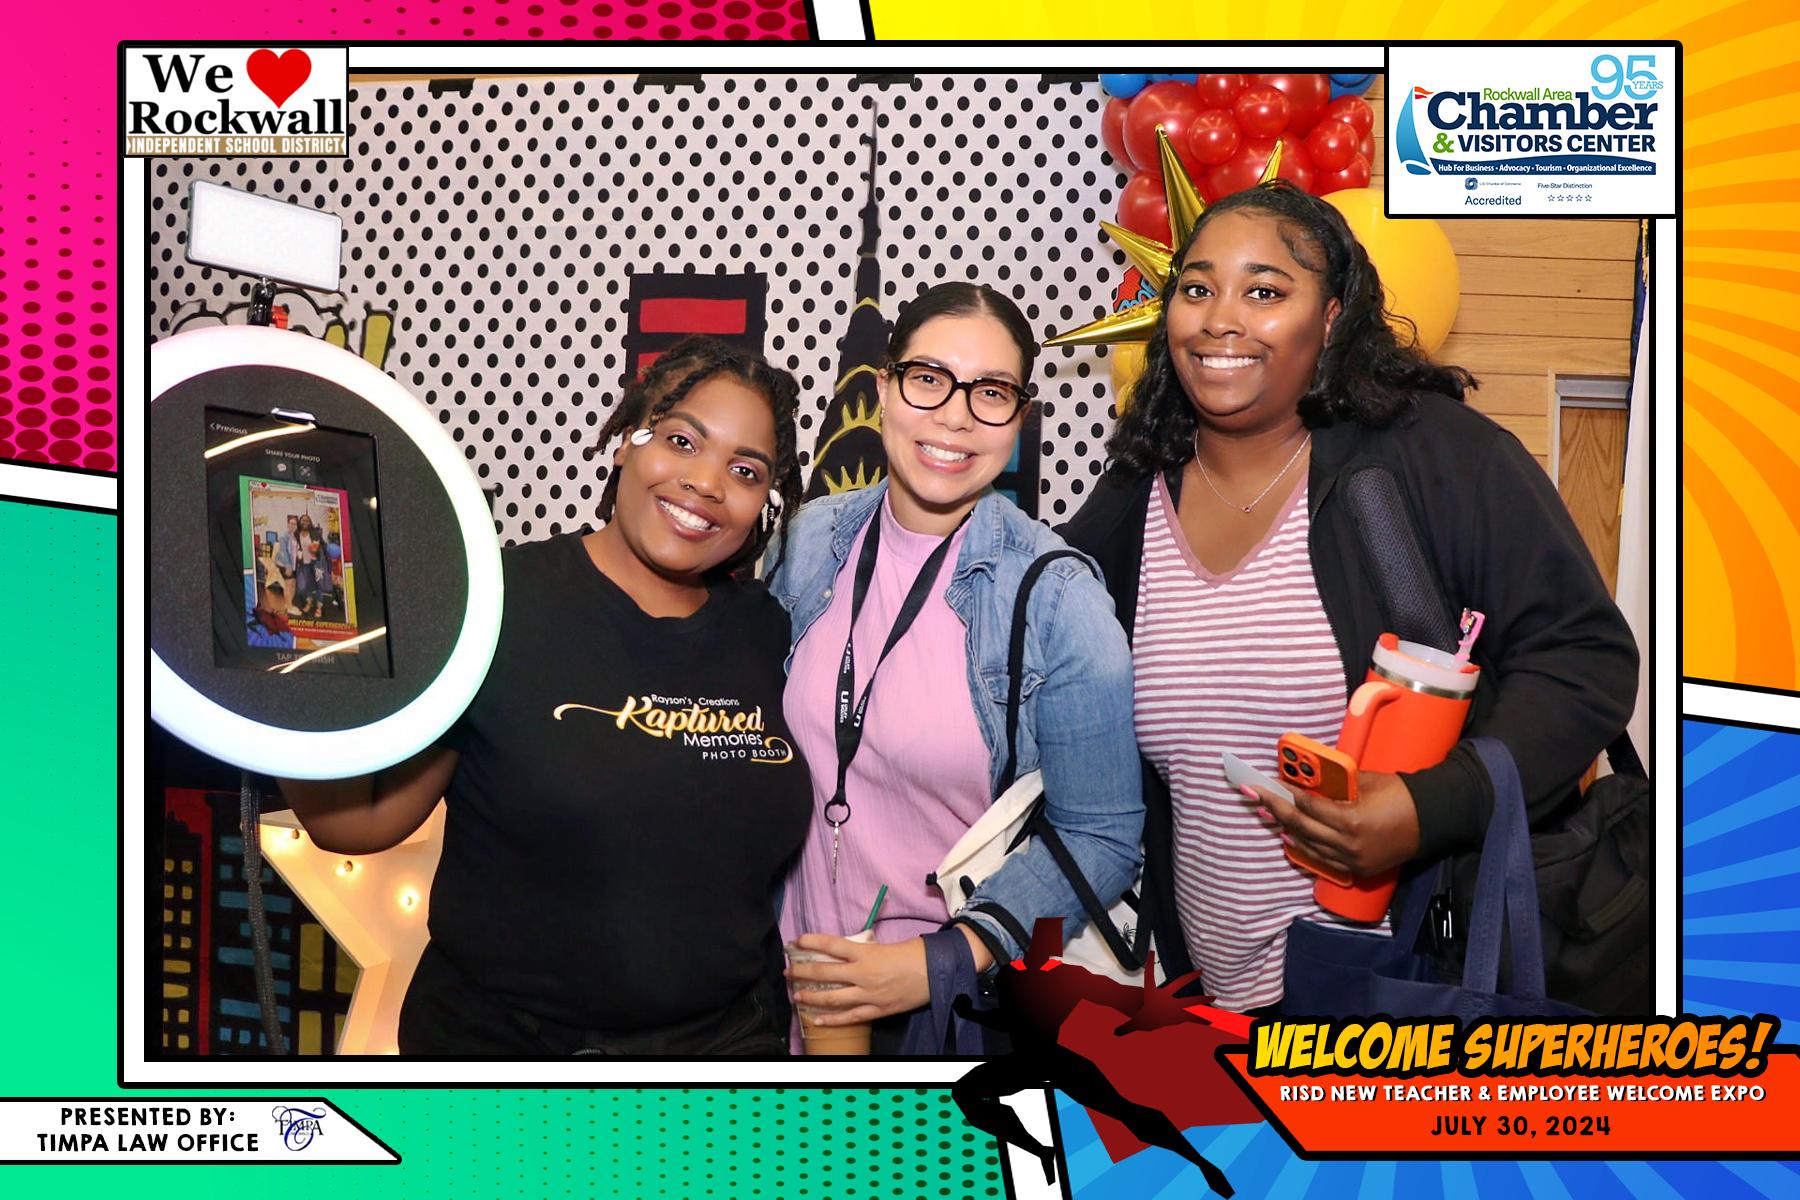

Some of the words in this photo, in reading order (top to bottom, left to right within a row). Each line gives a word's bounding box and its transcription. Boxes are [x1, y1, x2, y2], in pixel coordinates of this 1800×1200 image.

[216, 423, 248, 435] Previous
[265, 448, 283, 456] SHARE
[284, 451, 300, 459] YOUR
[301, 454, 321, 463] PHOTO
[651, 694, 693, 706] Rayson's
[698, 696, 740, 706] Creations
[612, 695, 765, 740] Kaptured
[683, 731, 763, 748] Memories
[702, 750, 747, 761] PHOTO
[752, 749, 788, 759] BOOTH
